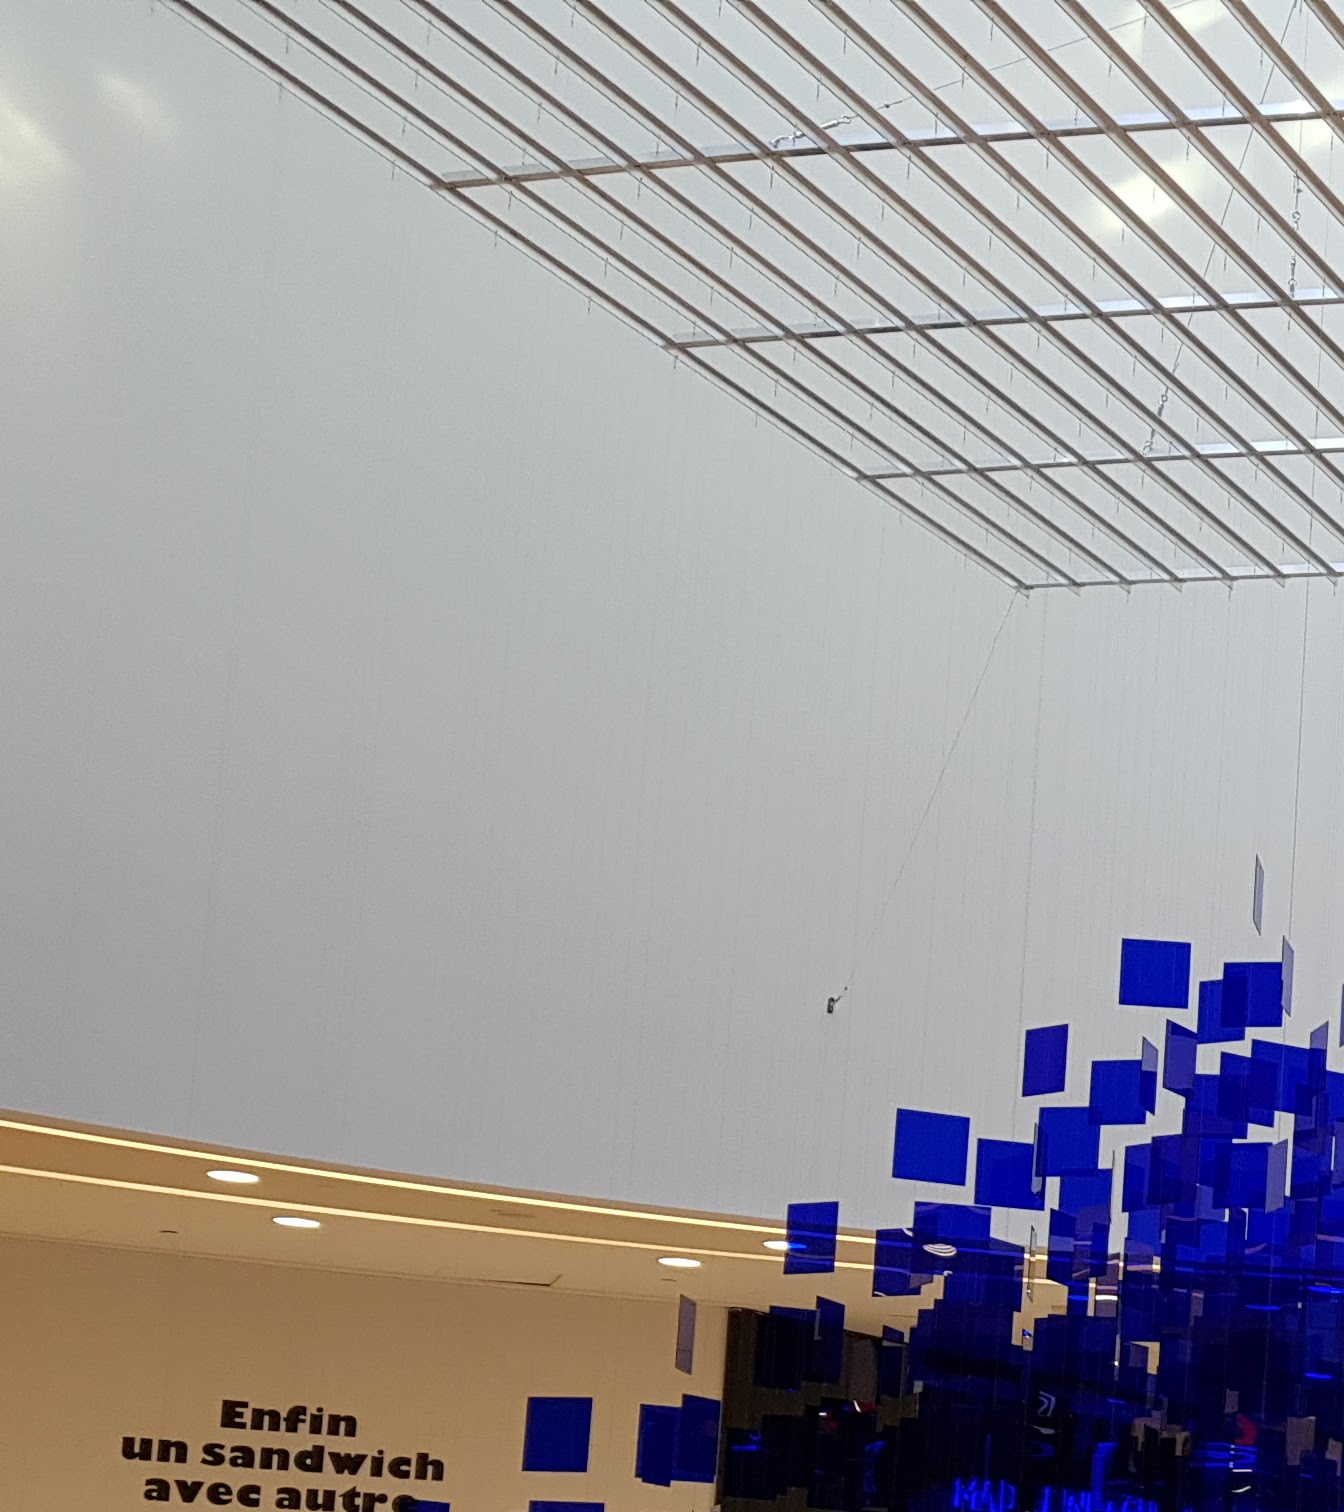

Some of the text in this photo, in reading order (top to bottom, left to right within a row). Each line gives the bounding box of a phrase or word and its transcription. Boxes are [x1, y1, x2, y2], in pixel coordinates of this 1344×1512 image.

[220, 1399, 358, 1438] Enfin
[121, 1435, 445, 1481] un sandwich
[143, 1477, 261, 1508] avec
